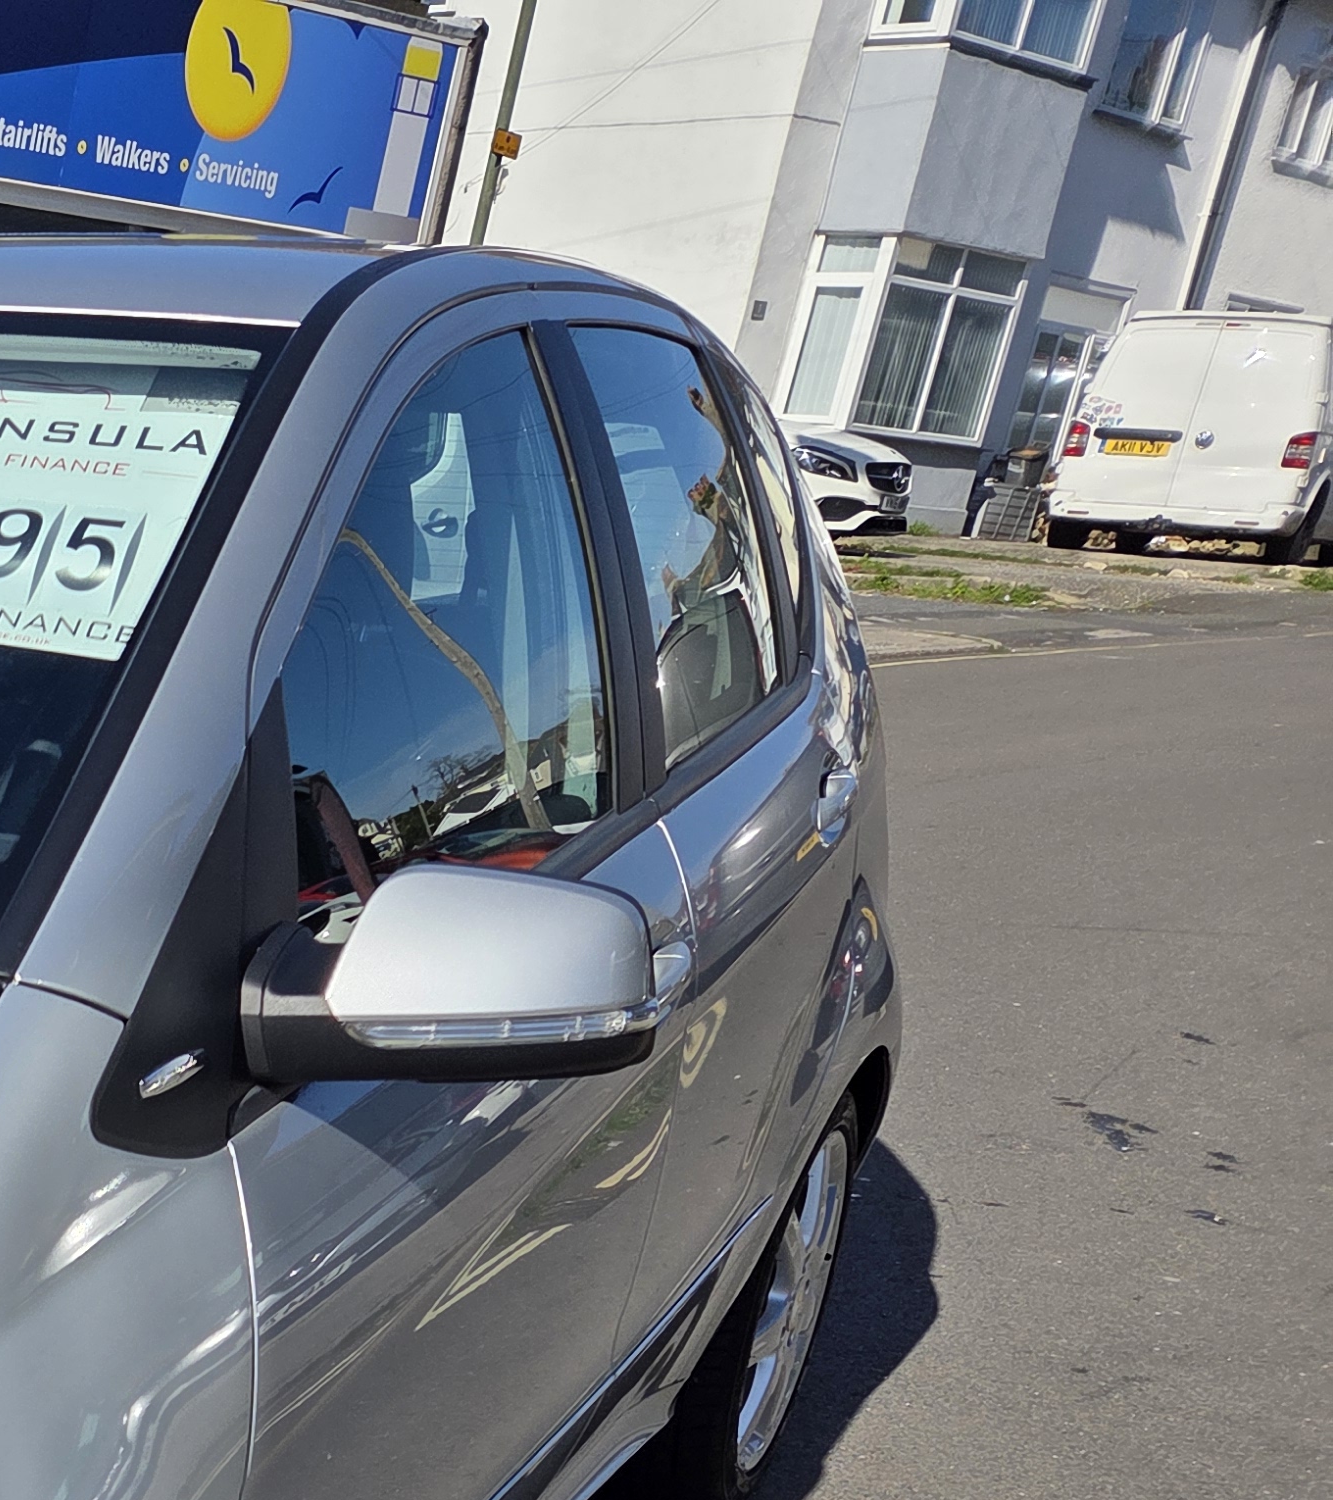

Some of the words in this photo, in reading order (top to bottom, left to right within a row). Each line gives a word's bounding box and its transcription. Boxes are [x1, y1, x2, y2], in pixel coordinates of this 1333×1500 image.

[95, 135, 170, 175] Walkers
[195, 153, 279, 199] Servicing
[4, 453, 131, 477] FINANCE
